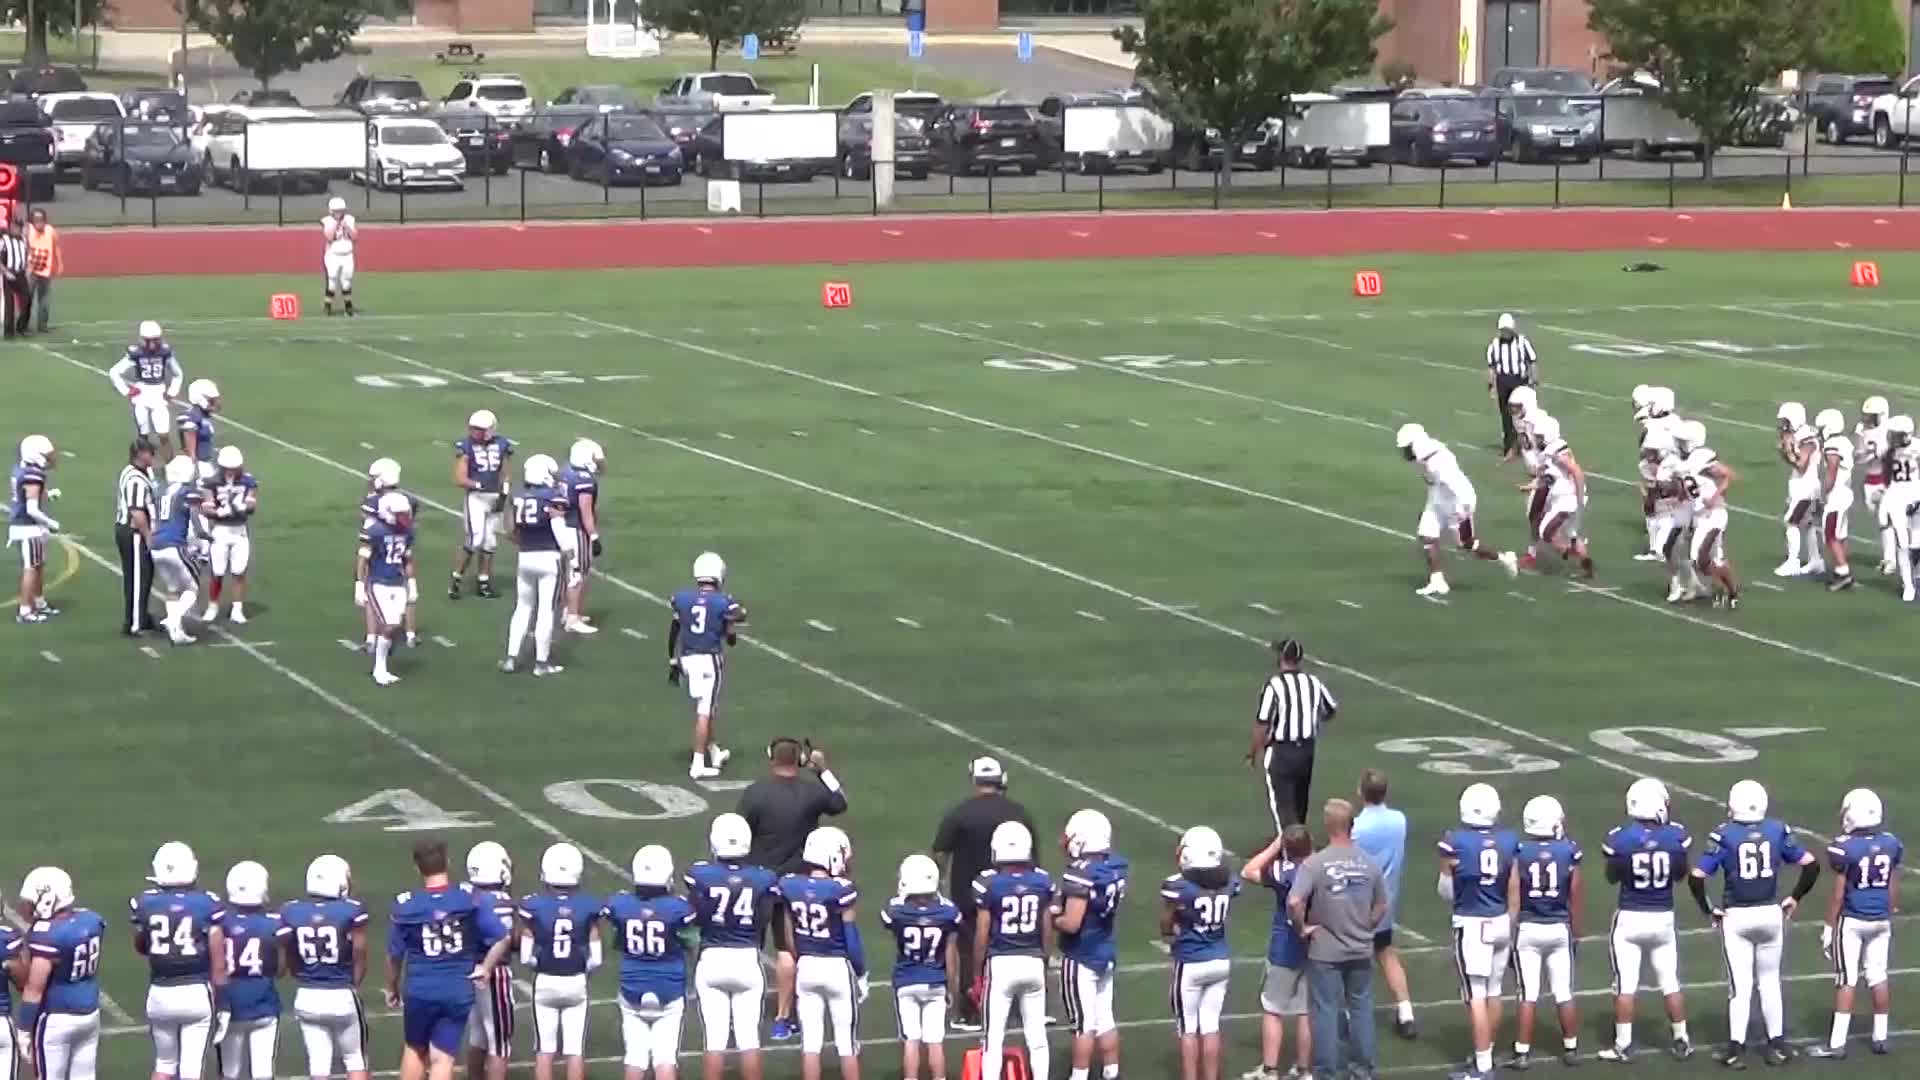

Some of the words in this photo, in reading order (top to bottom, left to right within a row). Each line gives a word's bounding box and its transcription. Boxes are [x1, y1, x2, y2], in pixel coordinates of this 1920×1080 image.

[690, 605, 706, 634] 3
[1479, 848, 1498, 886] 9
[1528, 860, 1560, 898] 11
[1632, 850, 1671, 889] 50
[1738, 840, 1774, 880] 61
[1857, 855, 1891, 890] 13
[708, 886, 754, 925] 74
[790, 900, 831, 939] 32
[1000, 894, 1040, 934] 20
[1193, 894, 1229, 933] 30
[149, 914, 198, 955] 24
[297, 925, 340, 965] 63
[552, 918, 574, 958] 6
[625, 918, 666, 957] 66
[903, 926, 943, 965] 27
